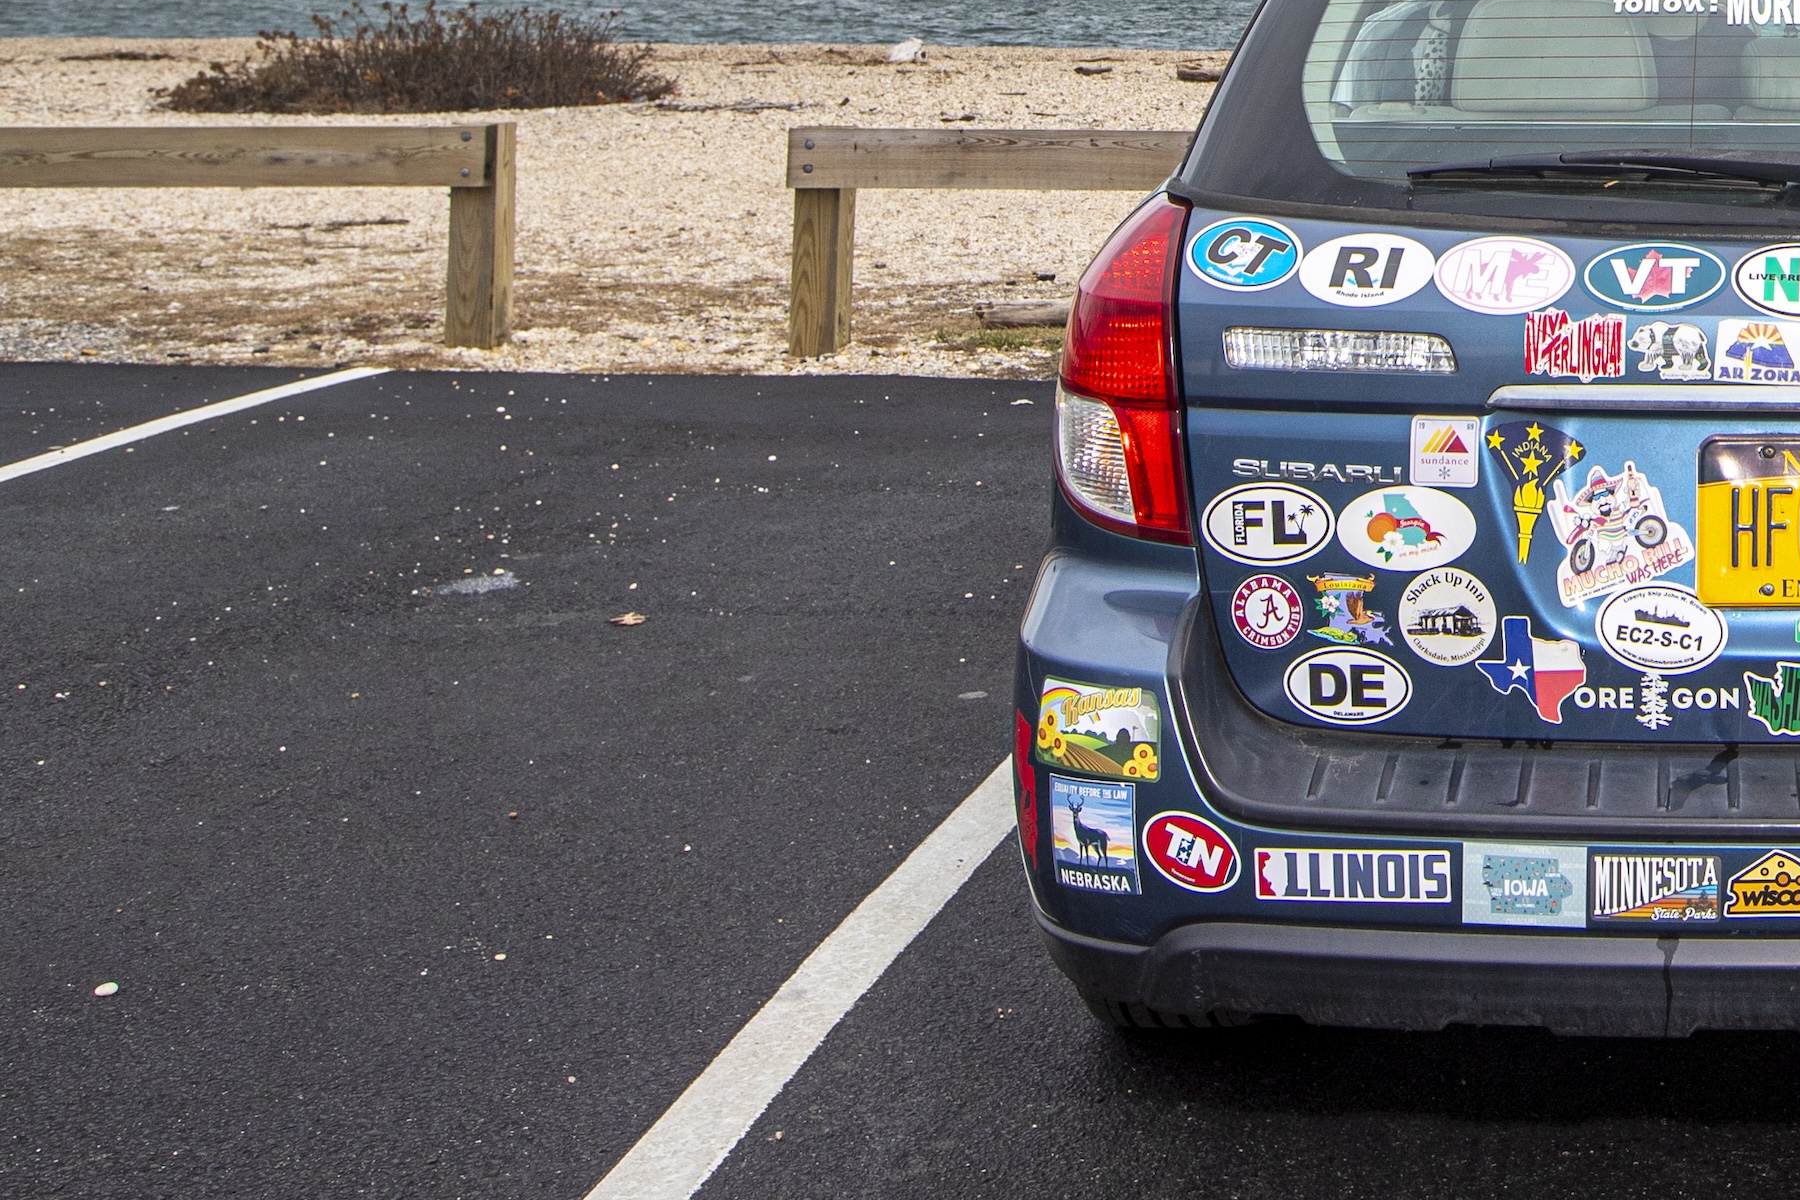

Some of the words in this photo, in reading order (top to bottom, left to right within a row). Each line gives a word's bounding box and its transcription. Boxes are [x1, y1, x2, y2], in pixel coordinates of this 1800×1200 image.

[1207, 227, 1291, 277] CT
[1206, 266, 1244, 284] Connecticut
[1328, 246, 1405, 289] RI
[1452, 248, 1556, 300] ME
[1610, 258, 1700, 295] VT
[1749, 273, 1776, 282] LIVE
[1335, 289, 1359, 298] Rhode
[1360, 290, 1385, 298] Island
[1420, 456, 1469, 465] sundance
[1511, 441, 1553, 462] INDIANA
[1232, 458, 1402, 485] SUBARU
[1231, 500, 1308, 546] FL
[1234, 503, 1245, 544] FLORIDA
[1399, 519, 1425, 529] Georgia
[1408, 549, 1419, 558] my
[1420, 544, 1438, 555] mind
[1563, 554, 1639, 597] MUCHO
[1642, 538, 1689, 564] BILL
[1626, 564, 1651, 585] WAS
[1653, 549, 1684, 573] HERE
[1236, 578, 1292, 617] ALABAMA
[1323, 582, 1368, 590] Louisiana
[1406, 574, 1441, 605] Shack
[1445, 572, 1462, 587] Up
[1464, 579, 1485, 603] Inn
[1256, 593, 1284, 629] A
[1623, 592, 1646, 603] Liberty
[1689, 600, 1708, 615] Brown
[1242, 626, 1290, 646] CRIMSON
[1287, 605, 1300, 633] TIDE
[1616, 625, 1703, 651] EC2-S-C1
[1413, 637, 1449, 662] Clarksdale,
[1450, 637, 1486, 662] Mississippi
[1308, 663, 1387, 708] DE
[1061, 687, 1143, 727] Kansas
[1054, 782, 1078, 795] EQUALITY
[1079, 784, 1101, 799] BEFORE
[1112, 789, 1128, 800] LAW
[1164, 822, 1224, 878] TN
[1061, 868, 1131, 892] NEBRASKA
[1503, 878, 1549, 897] IOWA
[1594, 856, 1718, 916] MINNESOTA
[1651, 906, 1680, 921] State
[1683, 906, 1717, 921] Parks
